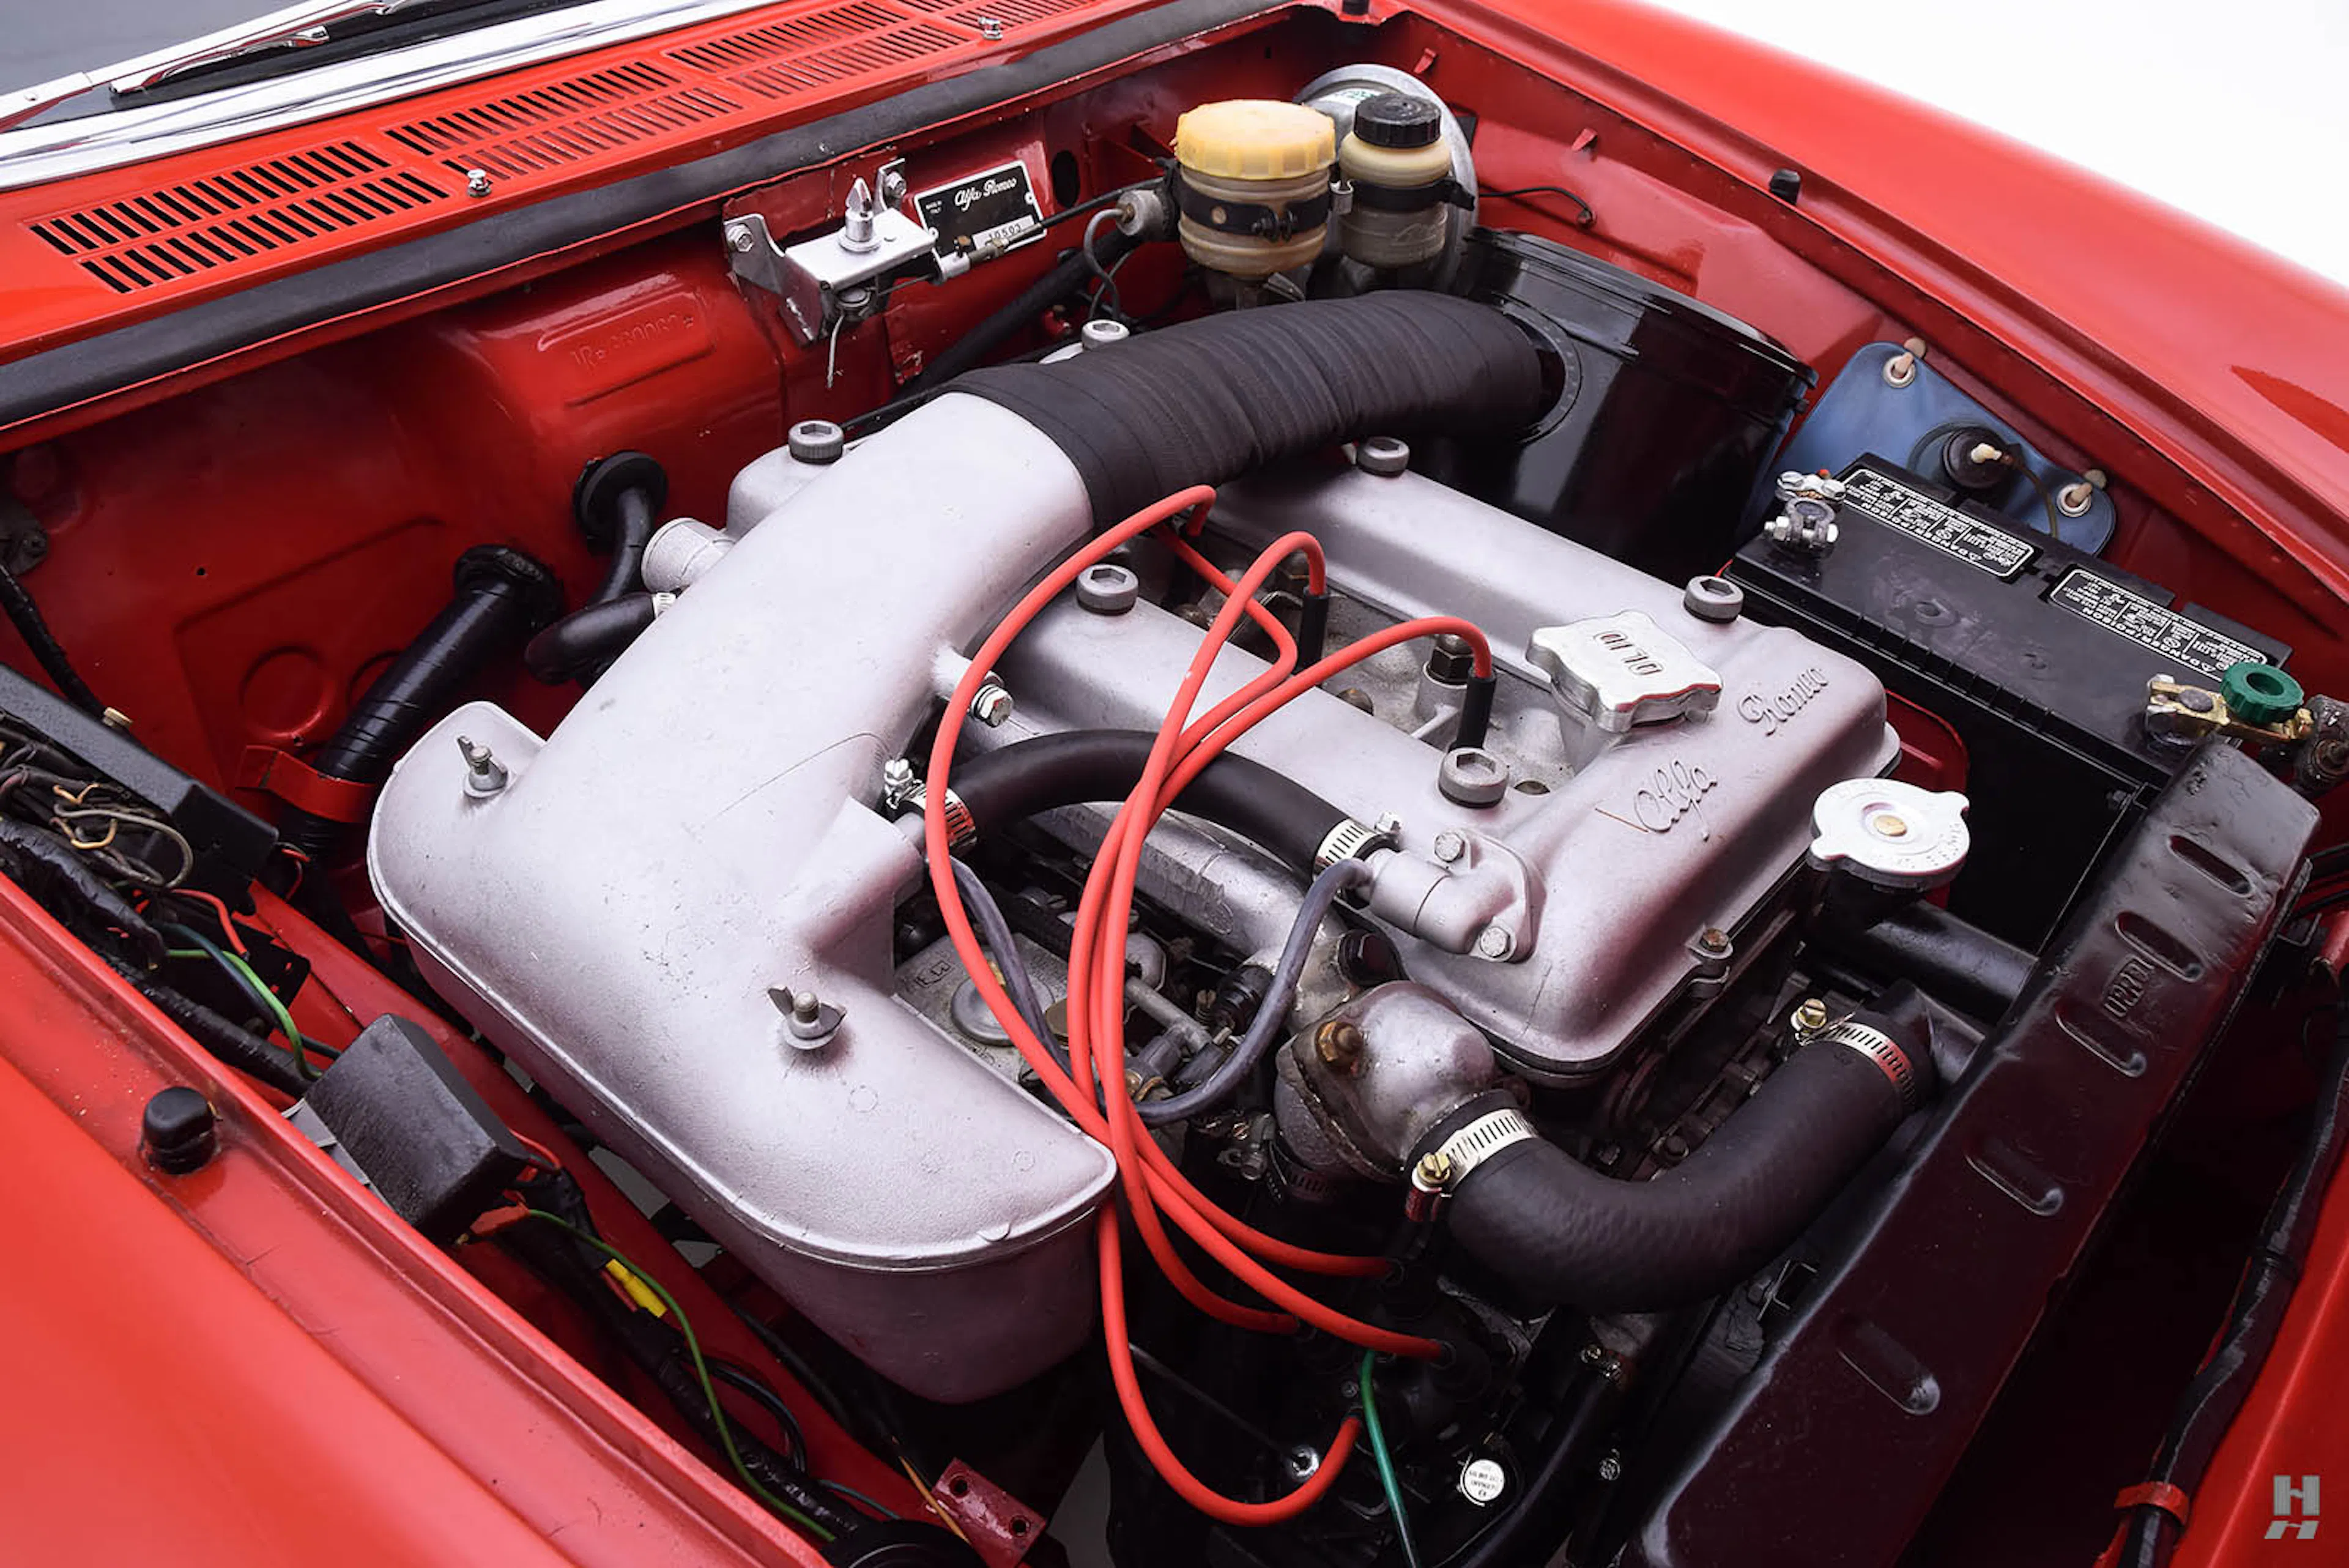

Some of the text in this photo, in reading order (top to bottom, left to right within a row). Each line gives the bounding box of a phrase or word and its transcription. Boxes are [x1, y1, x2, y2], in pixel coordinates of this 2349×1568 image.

[954, 187, 981, 212] Alfa
[983, 177, 1017, 197] Romeo
[1633, 666, 1828, 842] Alfa Romeo
